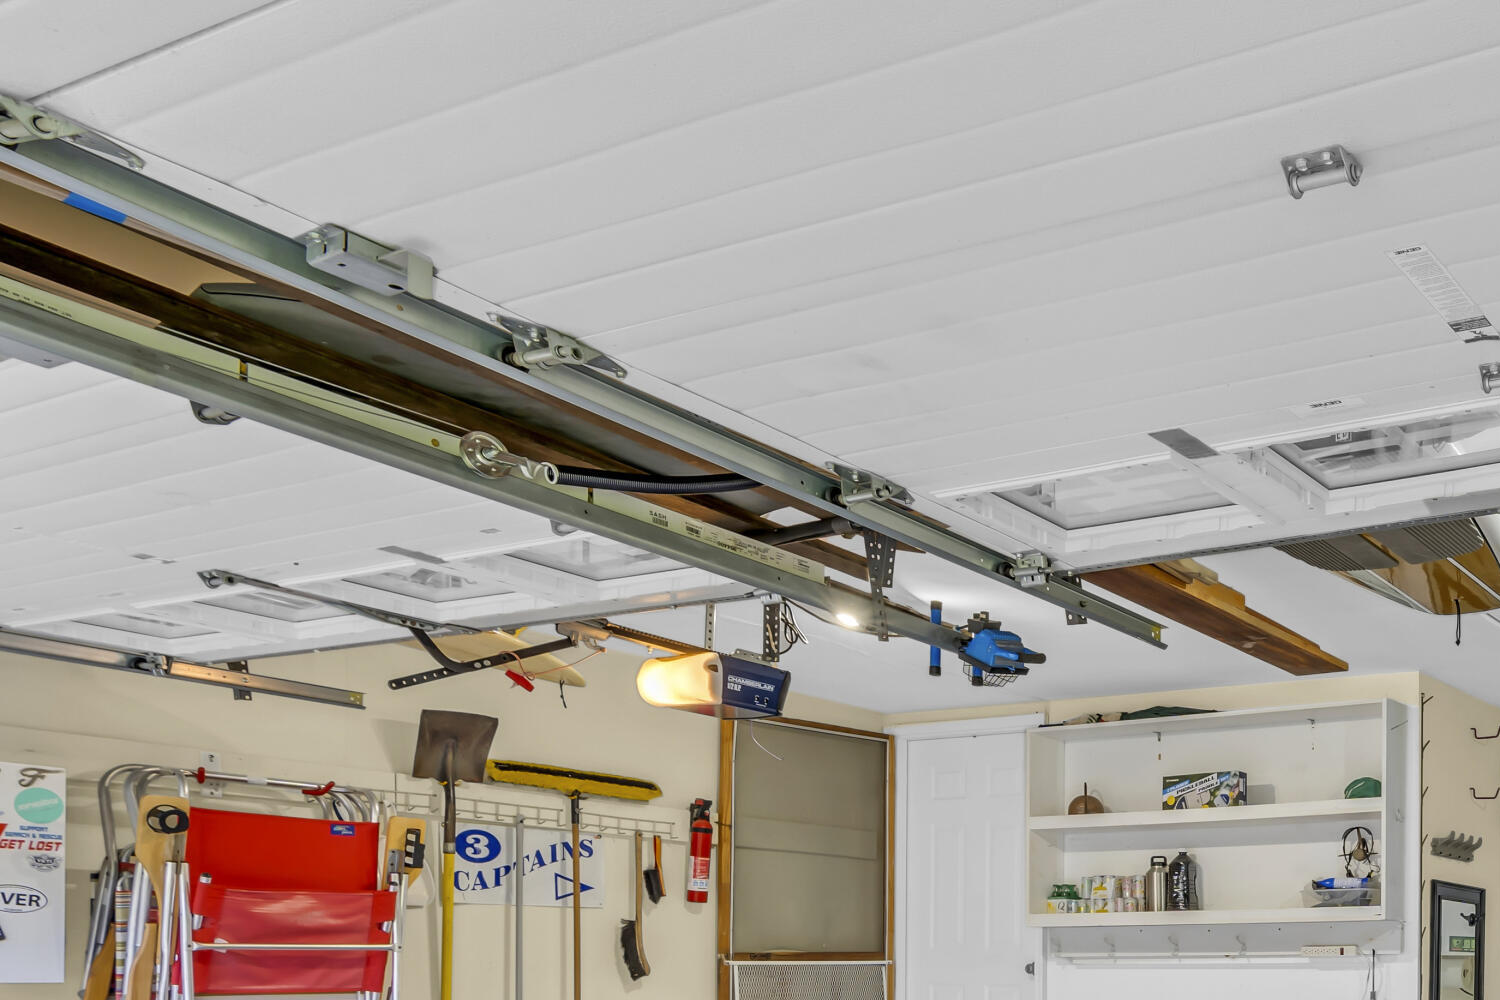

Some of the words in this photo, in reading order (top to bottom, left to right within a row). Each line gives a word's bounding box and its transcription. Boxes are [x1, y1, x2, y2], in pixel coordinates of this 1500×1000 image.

[649, 510, 667, 521] SASH
[727, 675, 776, 692] CHAMBERLAIN
[1176, 775, 1216, 795] PICKLEBALL
[0, 838, 26, 850] GET
[28, 841, 63, 852] LOST
[465, 834, 490, 859] 3
